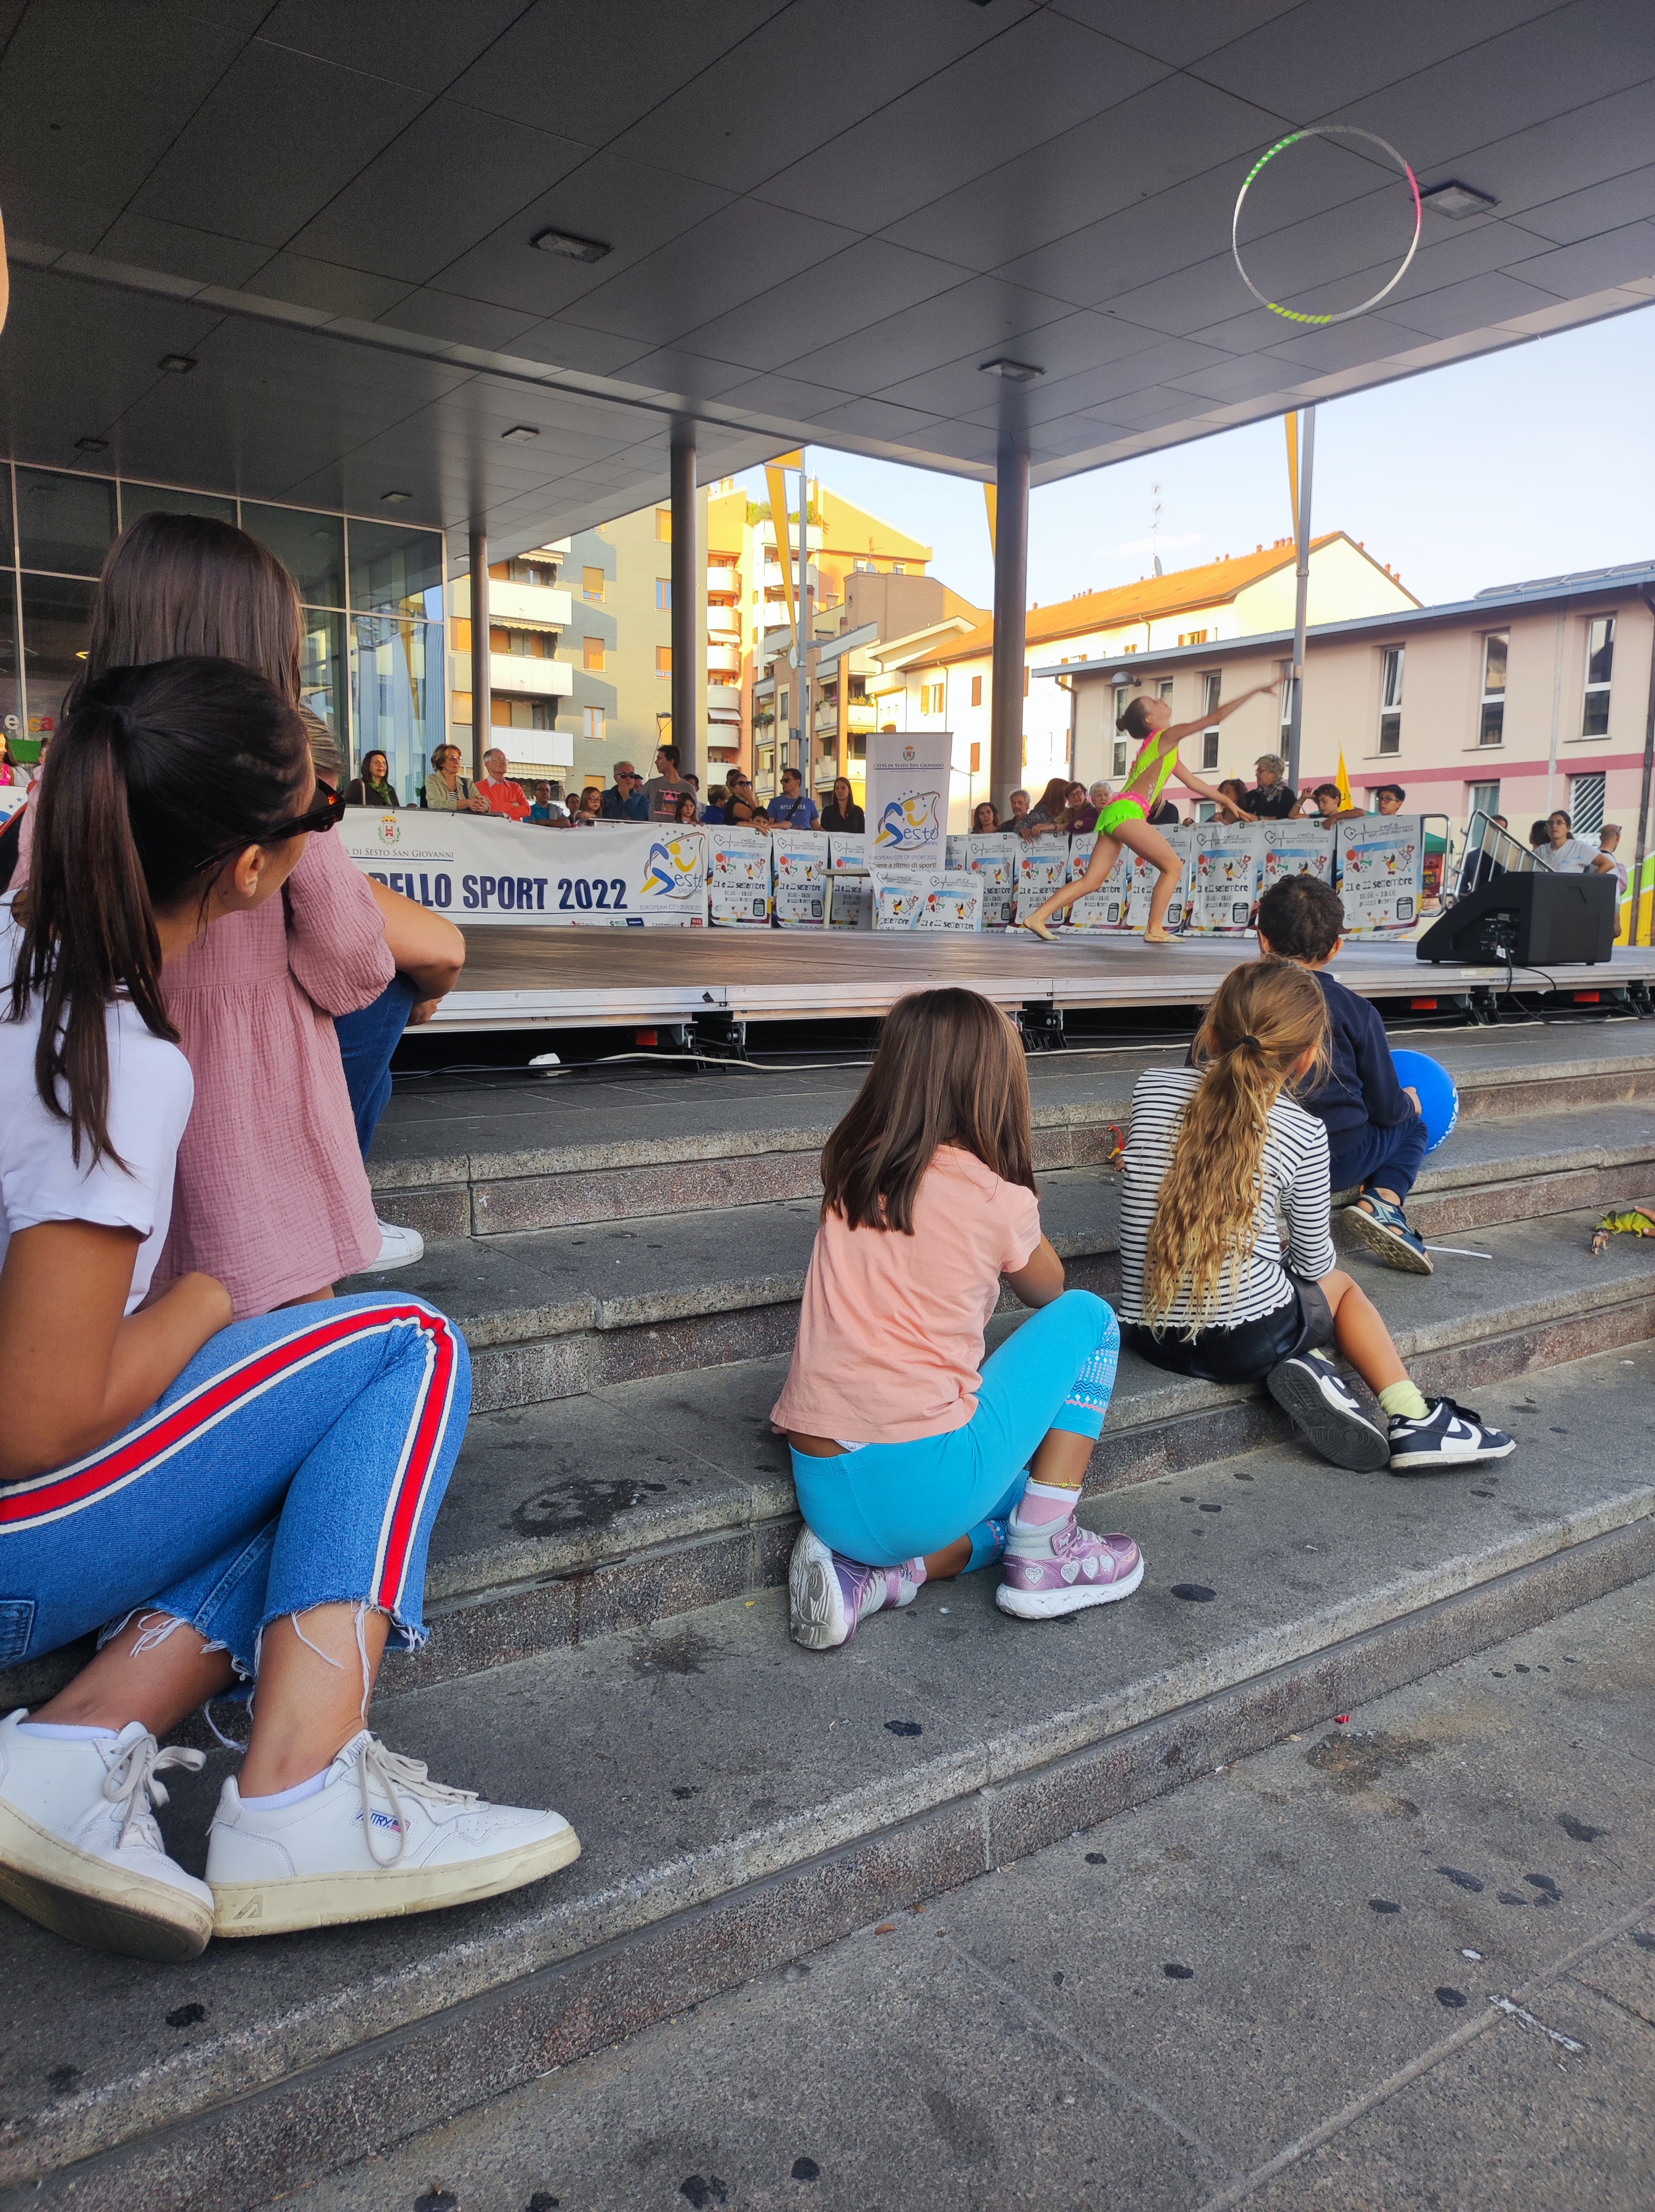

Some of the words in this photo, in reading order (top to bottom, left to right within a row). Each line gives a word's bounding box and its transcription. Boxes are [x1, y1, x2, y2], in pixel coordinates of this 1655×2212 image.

[365, 848, 390, 856] SESTO
[412, 850, 454, 858] GIOVANNI
[1372, 877, 1412, 889] settembre
[462, 874, 548, 910] SPORT
[558, 878, 628, 909] 2022
[943, 921, 974, 930] settembre
